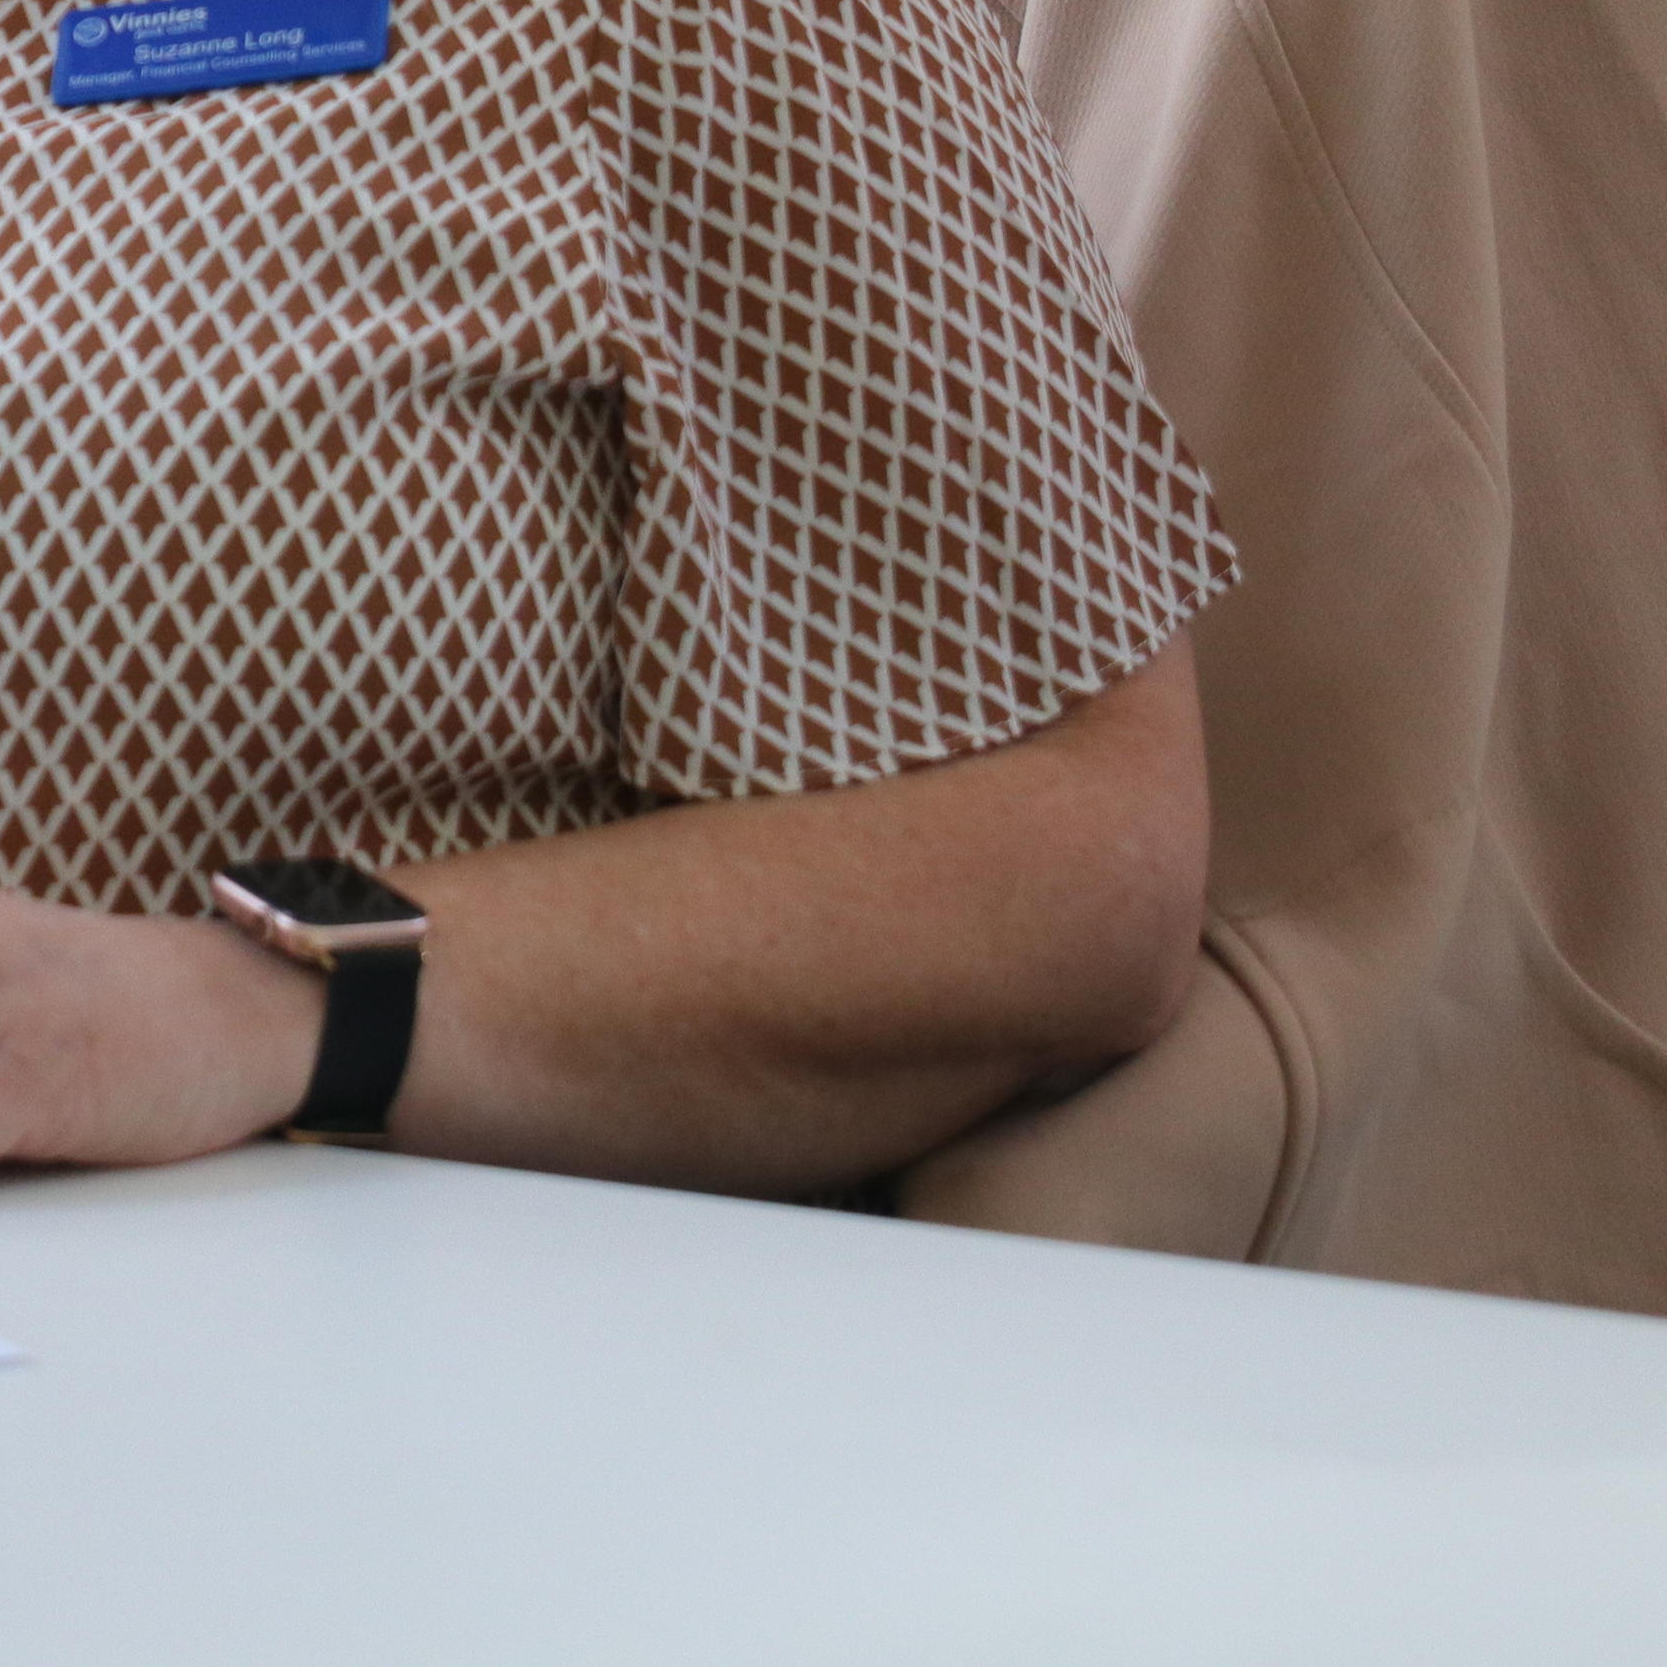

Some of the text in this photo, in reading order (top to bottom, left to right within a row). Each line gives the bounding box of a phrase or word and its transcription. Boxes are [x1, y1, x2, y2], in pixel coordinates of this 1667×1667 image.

[109, 6, 208, 33] Vinnies
[133, 27, 306, 65] Suzanne Long
[210, 48, 299, 71] Counselling
[301, 38, 366, 56] Services
